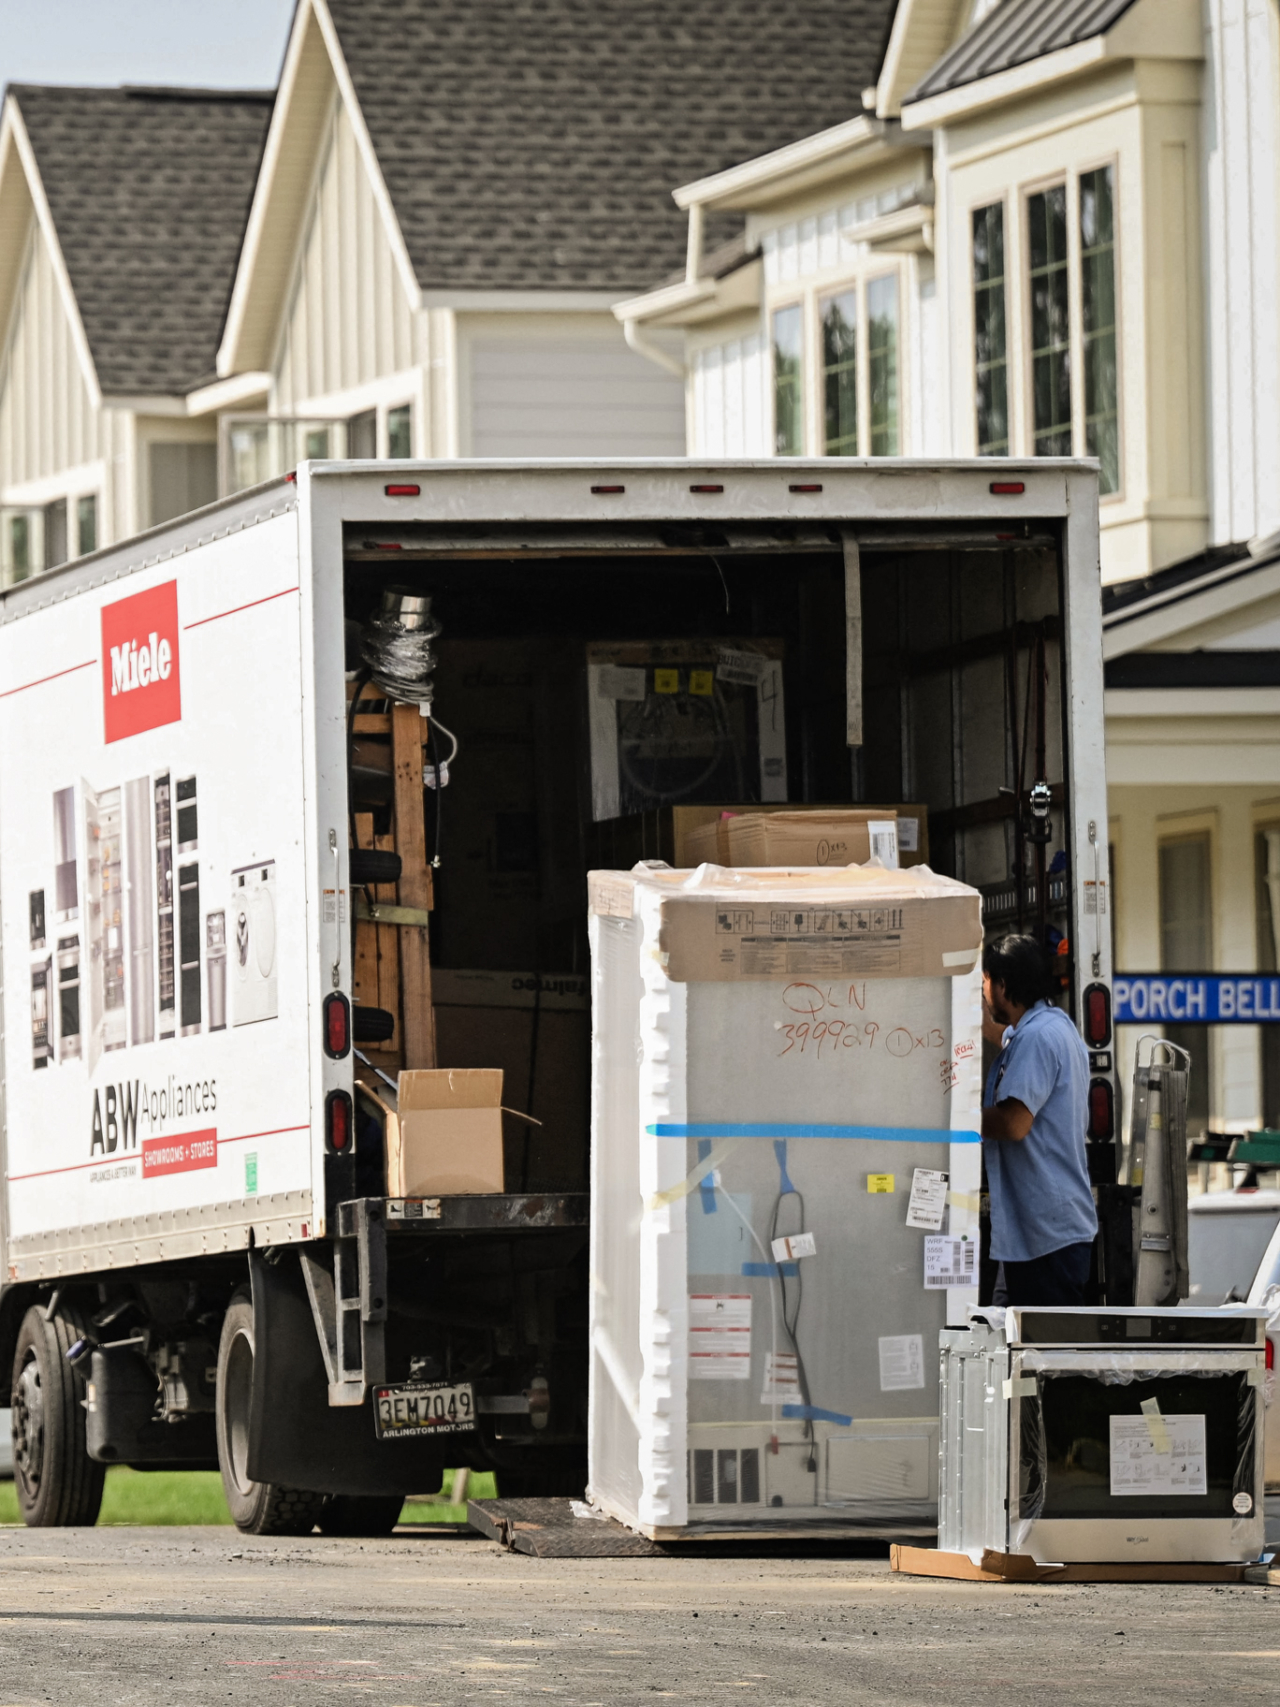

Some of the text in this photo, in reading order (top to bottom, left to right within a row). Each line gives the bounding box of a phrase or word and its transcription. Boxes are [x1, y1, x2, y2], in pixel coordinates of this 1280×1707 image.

[110, 632, 173, 696] Miele
[1113, 980, 1206, 1018] PORCH
[777, 1020, 879, 1059] 399929
[90, 1074, 217, 1156] ABW Appliances
[144, 1145, 184, 1168] SHOWROOMS
[190, 1140, 214, 1159] STORES
[380, 1392, 471, 1425] 3EM7049
[382, 1427, 435, 1438] ARLINGTON
